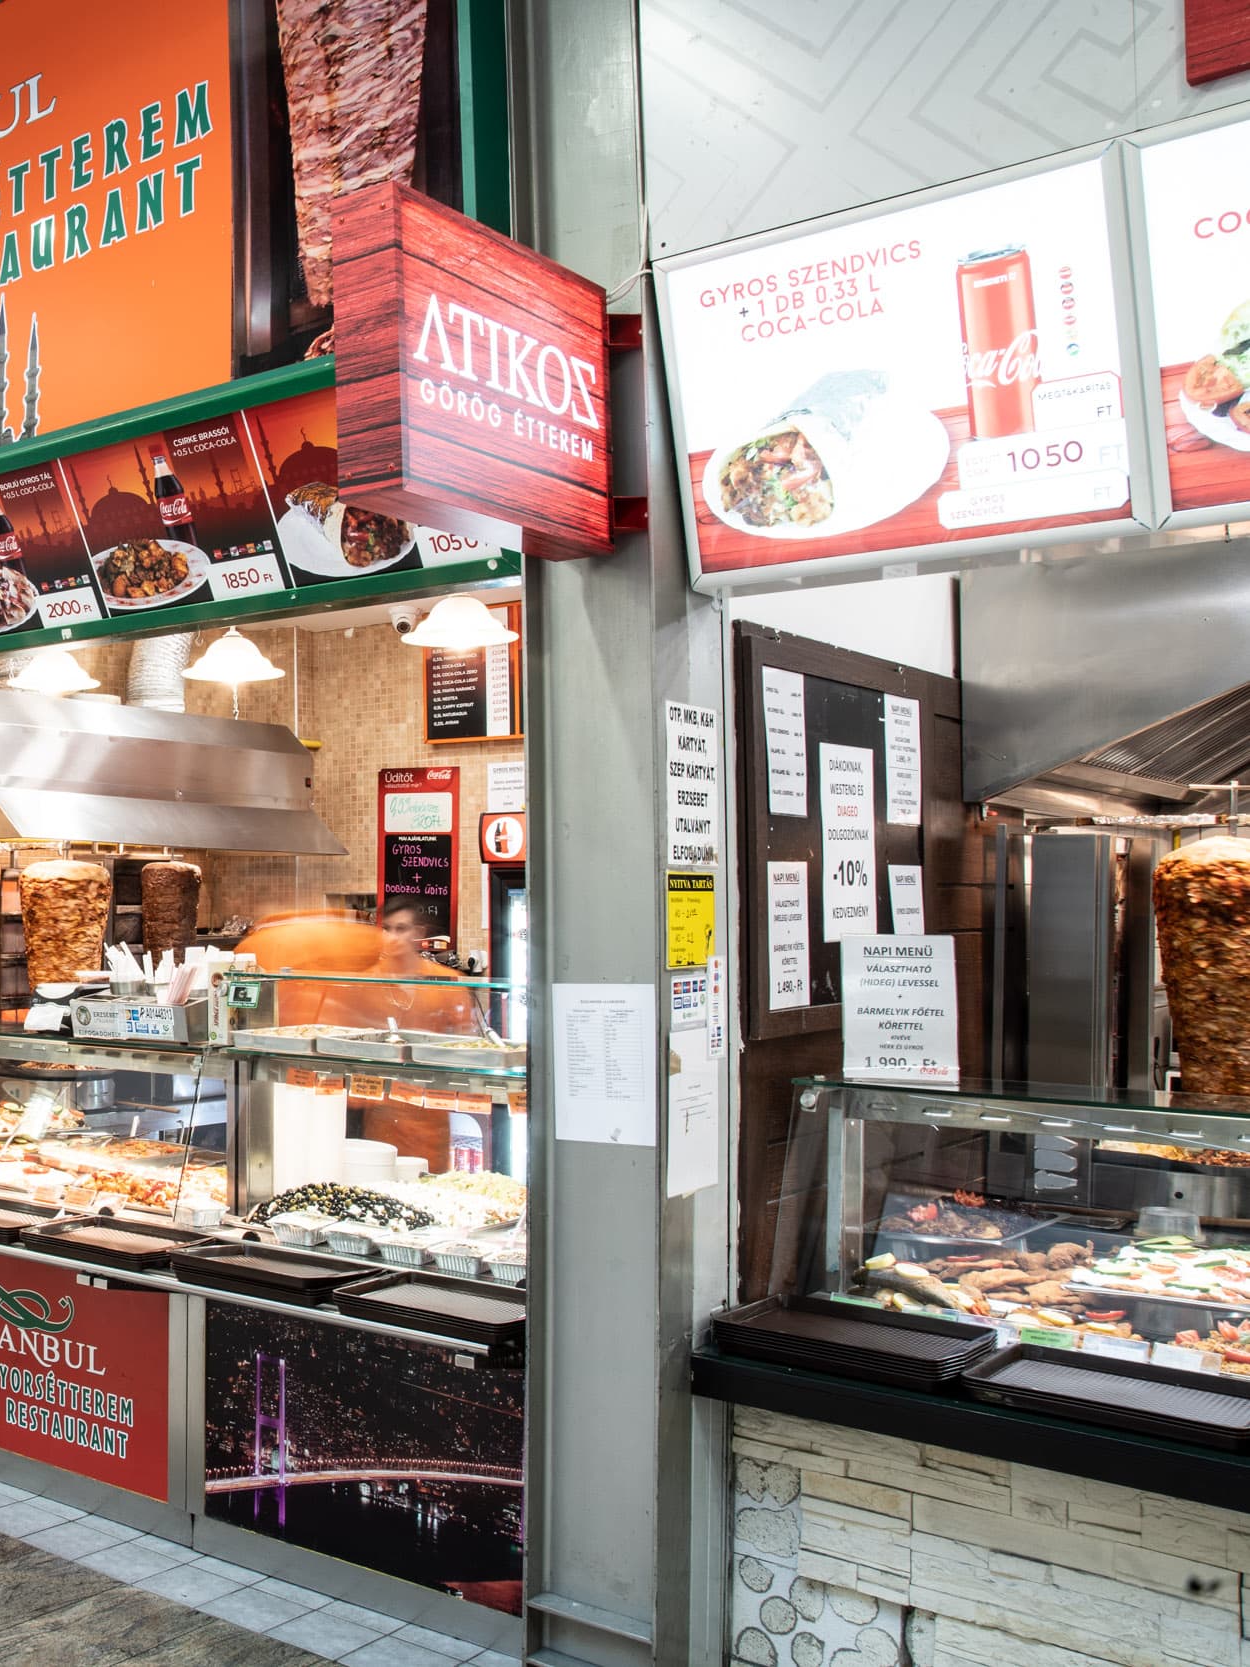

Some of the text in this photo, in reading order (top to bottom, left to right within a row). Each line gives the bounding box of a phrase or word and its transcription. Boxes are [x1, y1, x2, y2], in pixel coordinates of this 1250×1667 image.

[1194, 207, 1250, 239] CO
[700, 273, 778, 308] GYROS
[787, 240, 922, 290] SZENDVICS
[739, 276, 880, 318] + 1 DB 0.33 L
[741, 299, 884, 343] COCA-COLA
[420, 378, 594, 462] GÖRÖG ÉTTEREM
[1096, 405, 1113, 418] FT
[173, 426, 230, 447] CSIRKE BRASSÓI
[194, 435, 236, 453] COCA-COLA
[1007, 440, 1083, 472] 1050
[19, 475, 40, 487] GYROS
[21, 482, 55, 496] COCA-COLA
[222, 568, 274, 589] 1850 Ft
[47, 600, 81, 618] 2000
[670, 706, 714, 729] OTP, MKB, K&H
[670, 758, 684, 778] SZÉP
[678, 789, 708, 808] ERZSÉBET
[830, 783, 856, 796] WESTEND
[676, 815, 711, 835] UTALVÁNYT
[828, 825, 869, 841] DOLGOZÓKNAK
[392, 844, 422, 855] GYROS
[401, 856, 449, 867] SZENDVICS
[833, 859, 868, 887] -10%
[386, 884, 421, 894] DOBOZOS
[670, 877, 713, 889] NYITVA TARTÁS
[832, 905, 869, 919] KEDVEZMÉNY
[863, 944, 933, 957] NAPI MENÜ
[866, 963, 932, 973] VÁLASZTHATÓ
[860, 978, 939, 988] (HIDEG) LEVESSEL
[857, 1006, 945, 1017] BÁRMELYIK FŐÉTEL
[6, 1398, 128, 1460] RESTAURANT
